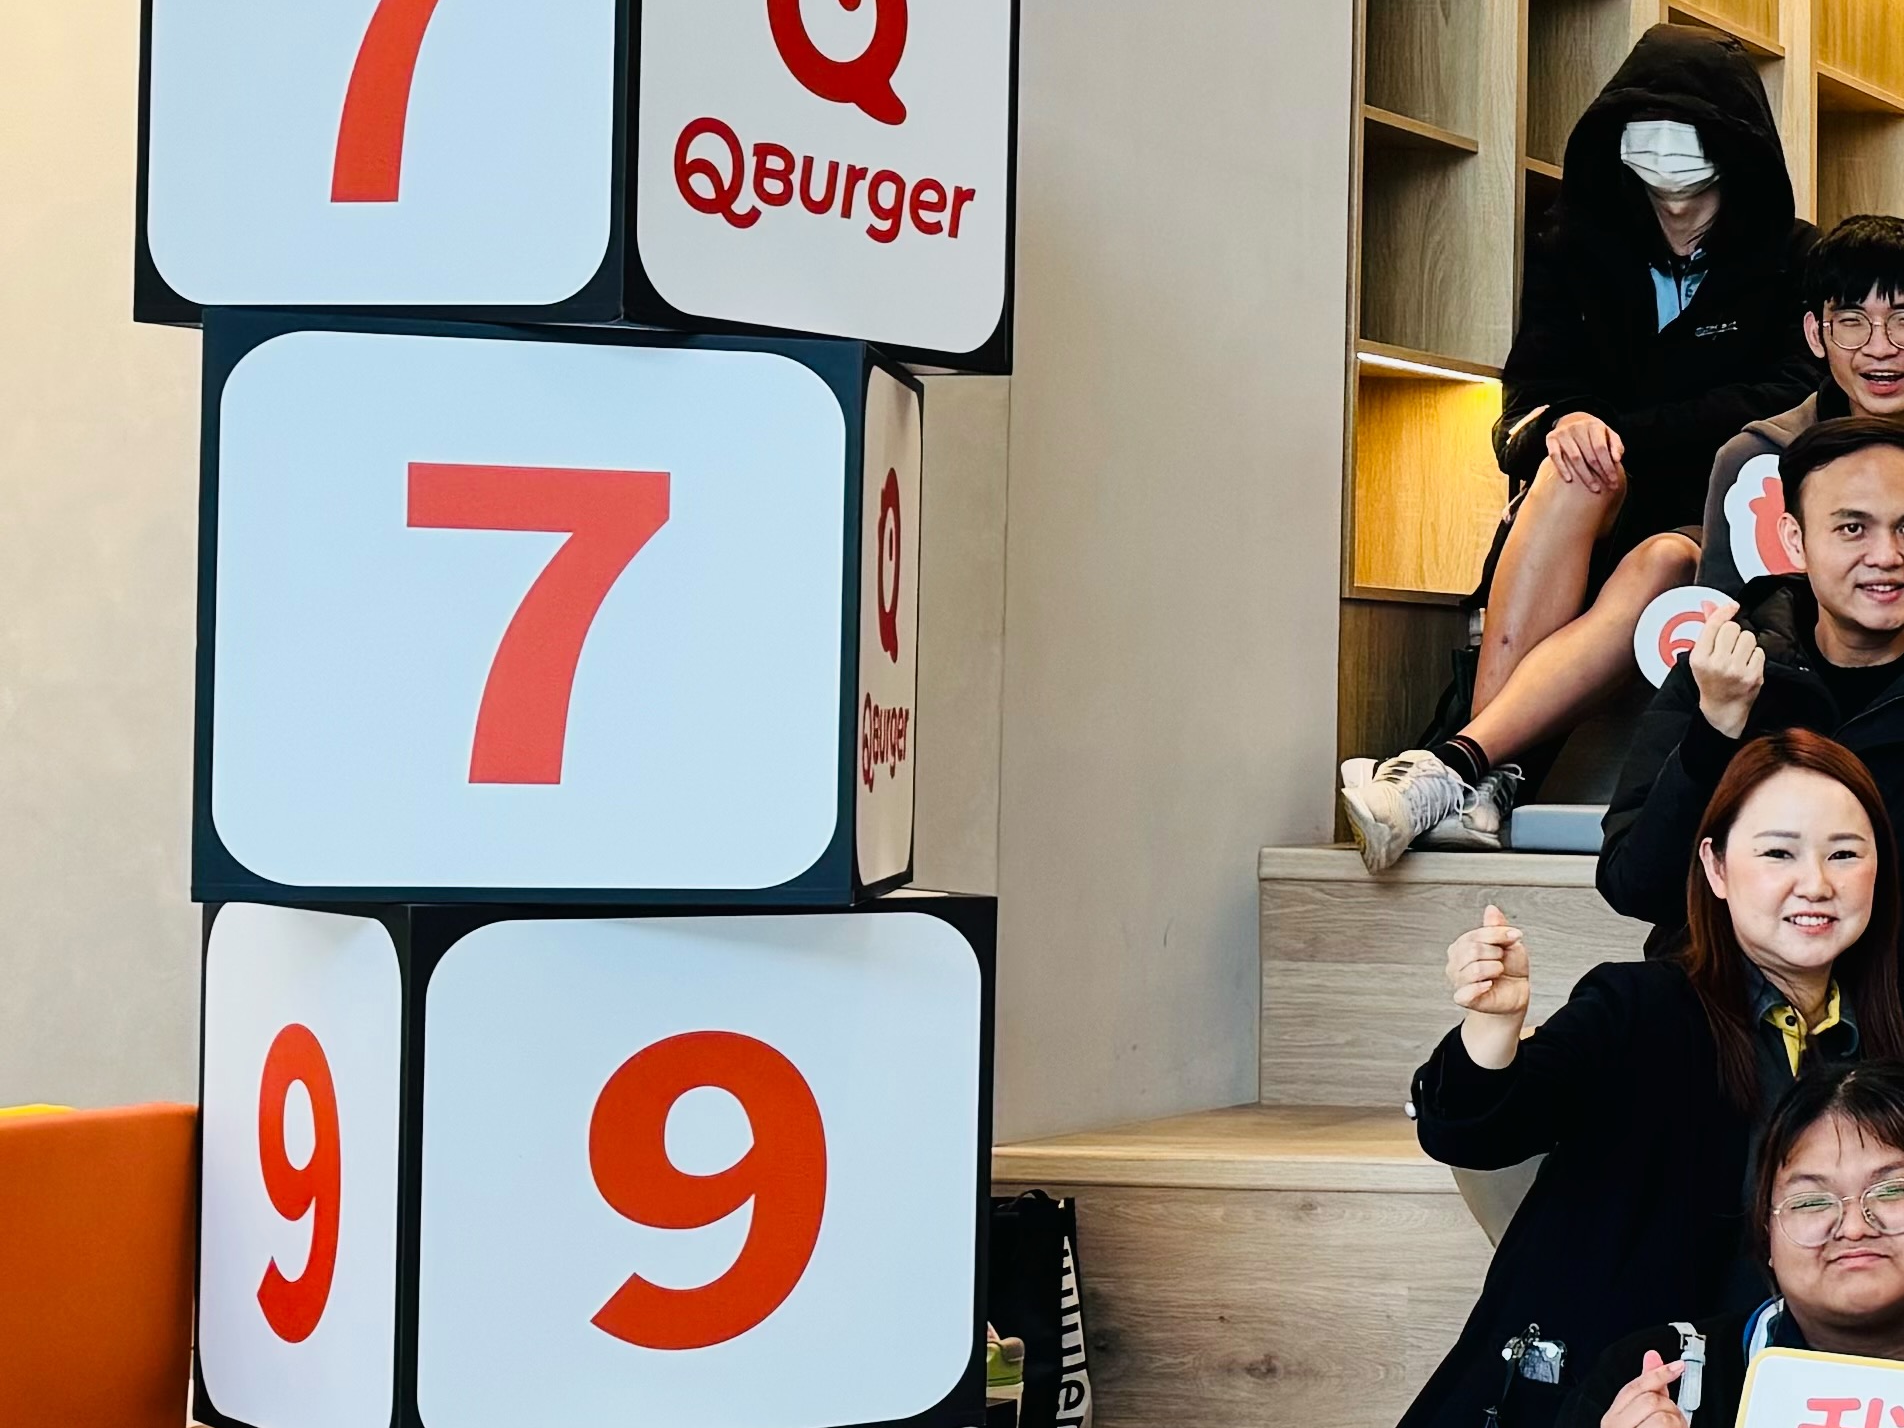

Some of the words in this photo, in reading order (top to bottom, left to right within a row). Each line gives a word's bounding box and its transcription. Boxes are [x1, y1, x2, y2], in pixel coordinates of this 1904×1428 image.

[674, 116, 978, 245] QBurger
[407, 462, 672, 786] 7
[256, 1022, 344, 1346] 9
[588, 1030, 830, 1353] 9
